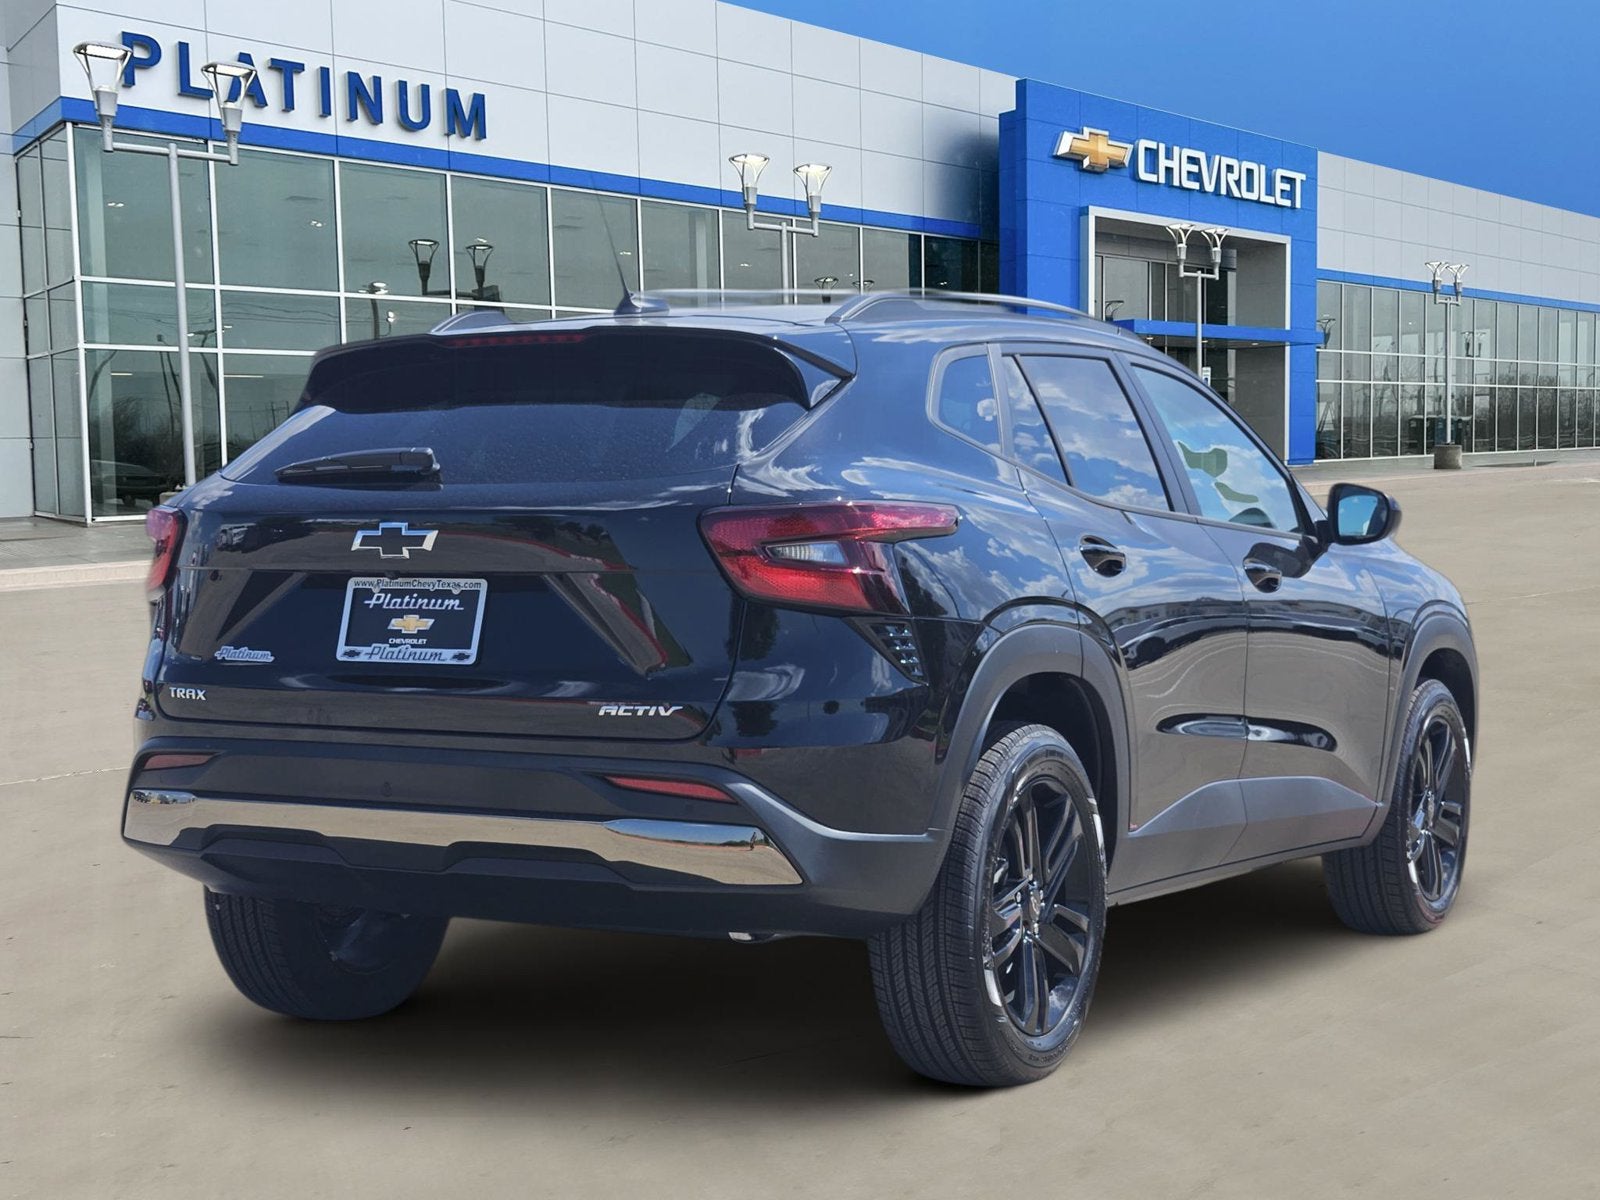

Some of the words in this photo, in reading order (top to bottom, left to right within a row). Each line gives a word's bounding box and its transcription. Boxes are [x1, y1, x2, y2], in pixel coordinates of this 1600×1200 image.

[119, 31, 487, 141] PLATINUM
[1136, 138, 1307, 209] CHEVROLET
[364, 593, 464, 611] Platinum
[214, 646, 275, 662] Platinum
[364, 645, 447, 662] Platinum
[169, 687, 207, 701] TRAX
[598, 705, 684, 717] ACTIV
